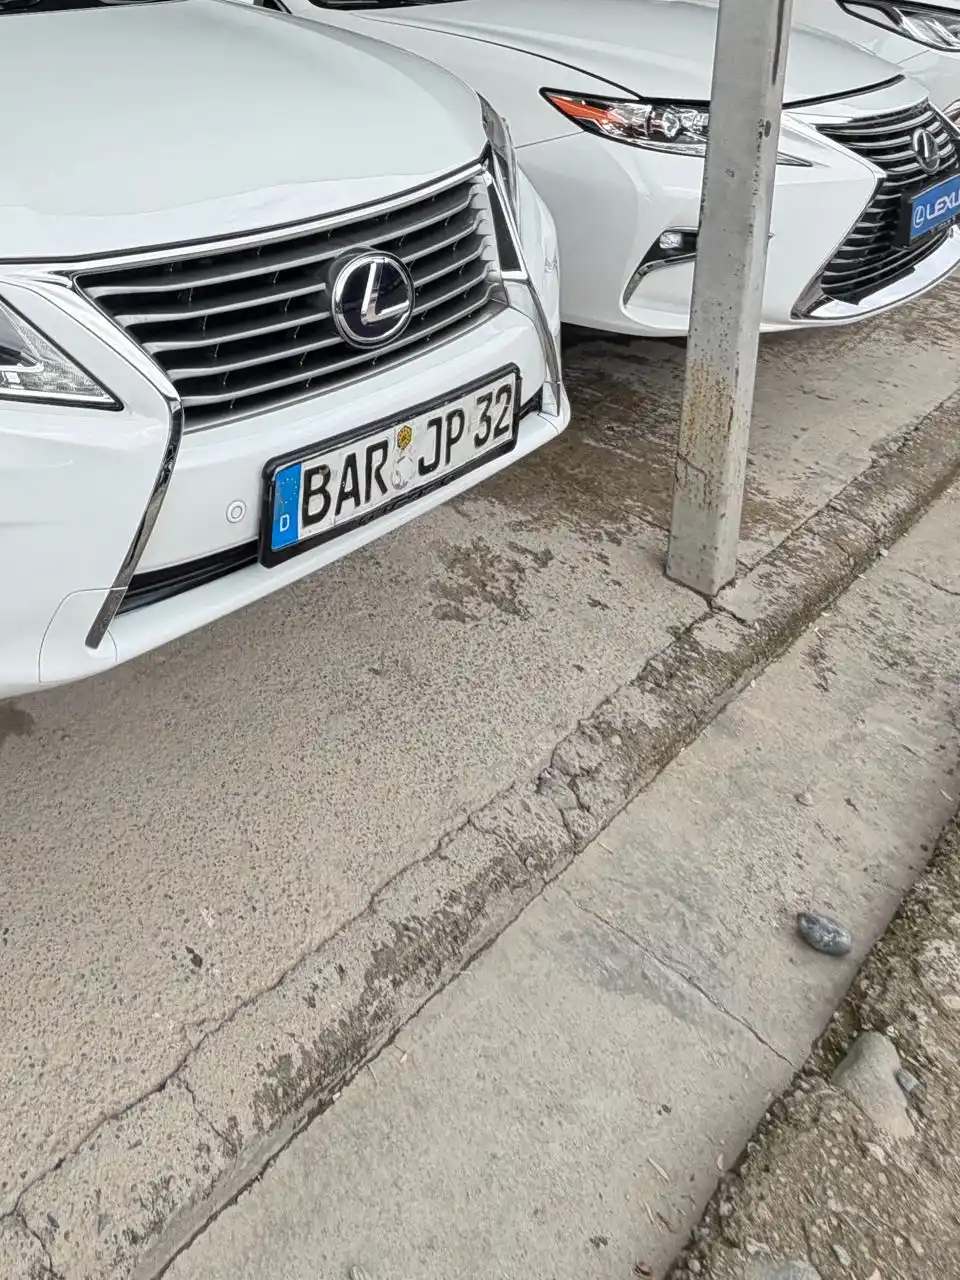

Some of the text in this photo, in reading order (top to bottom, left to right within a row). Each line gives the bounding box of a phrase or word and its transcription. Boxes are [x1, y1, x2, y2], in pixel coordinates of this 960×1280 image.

[926, 190, 960, 220] LEXU
[301, 439, 389, 529] BAR
[417, 408, 466, 477] JP
[473, 383, 513, 450] 32
[279, 514, 290, 532] D
